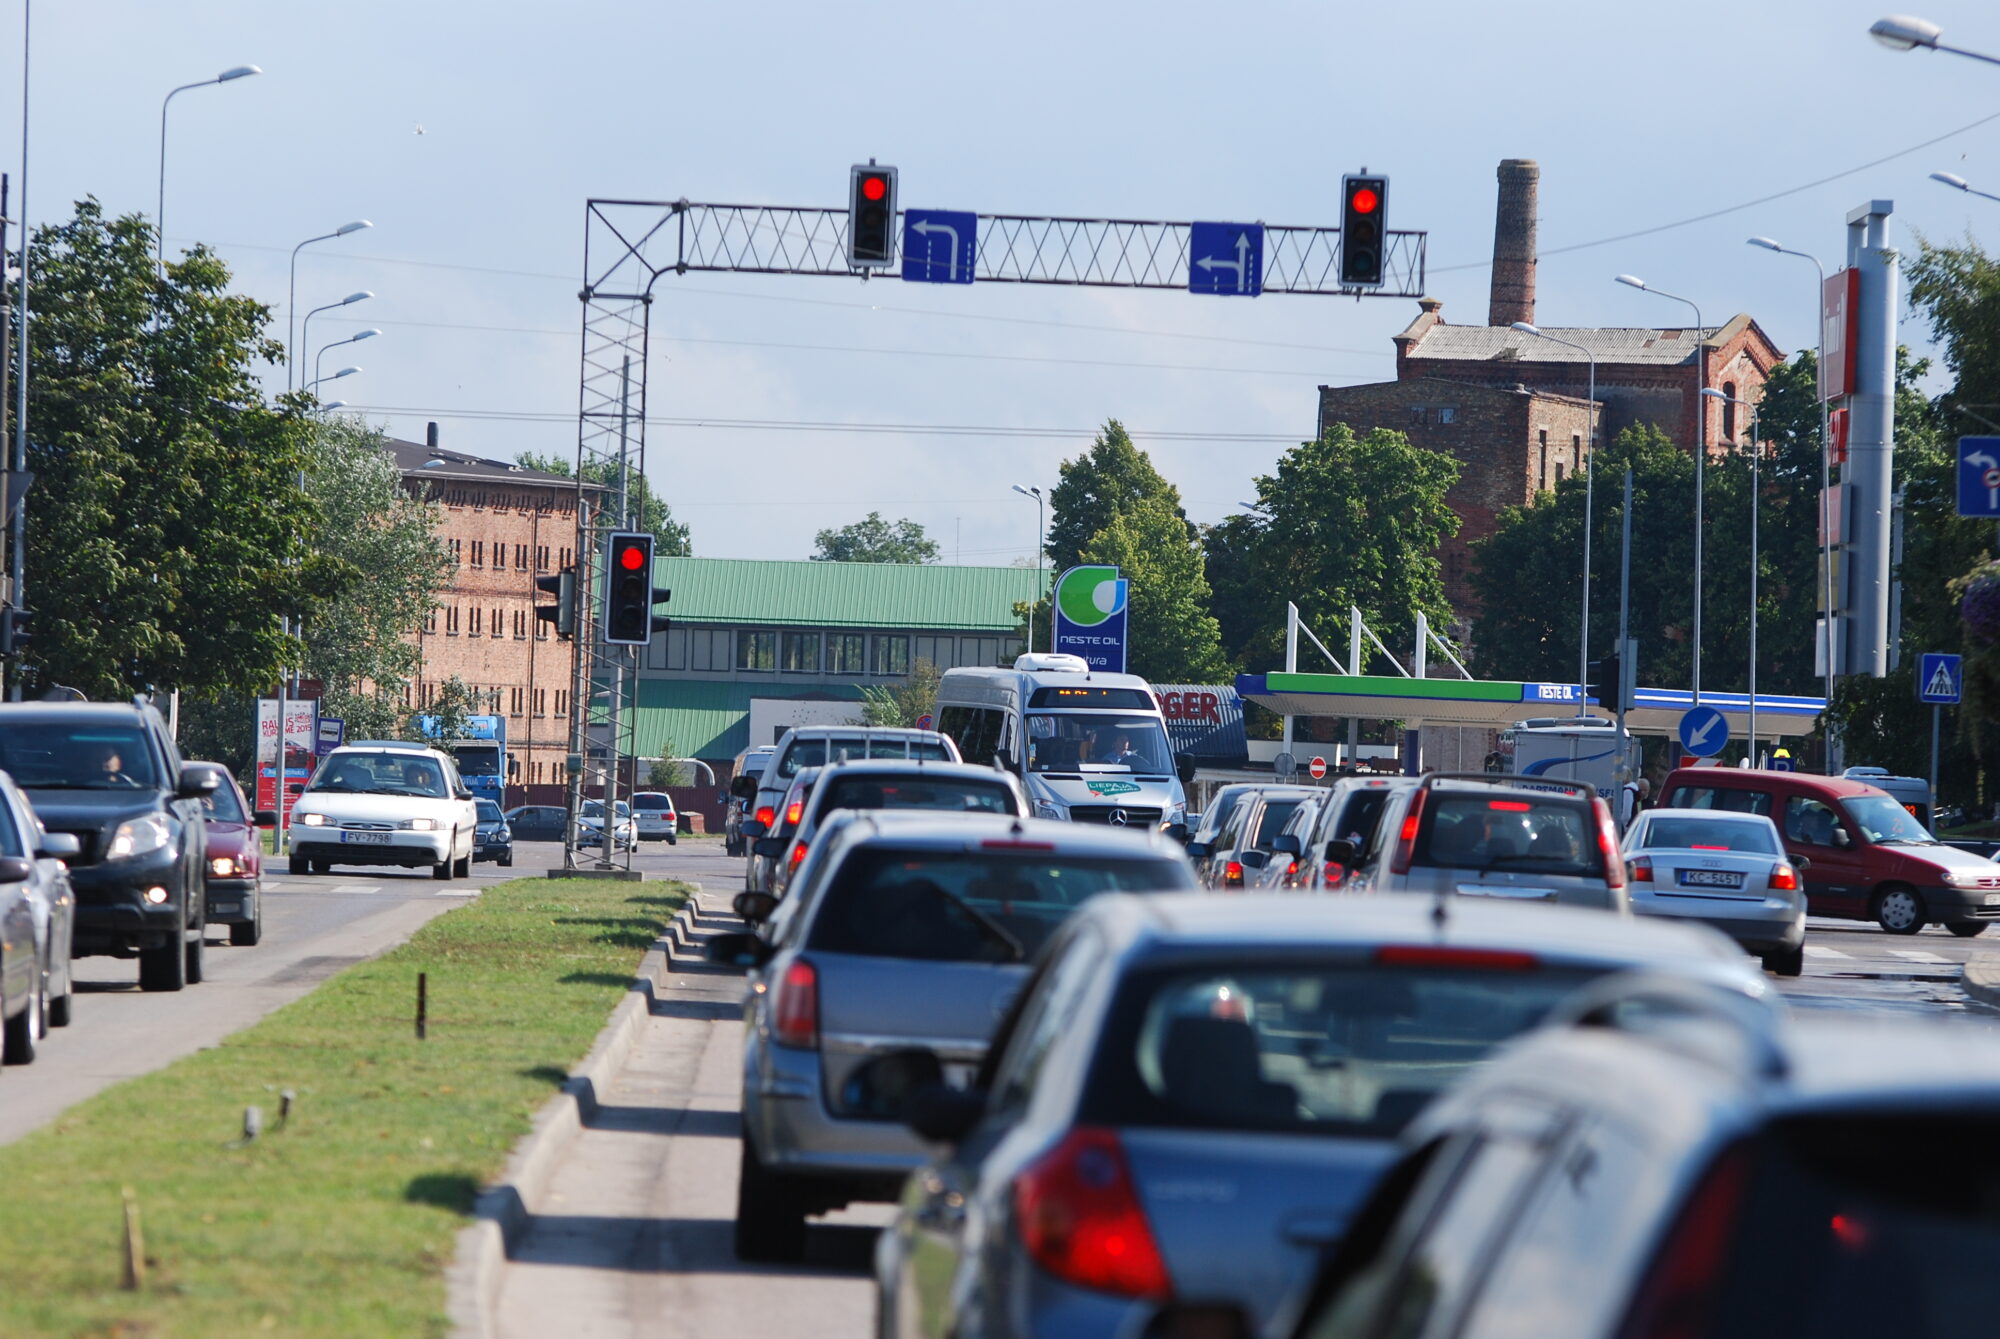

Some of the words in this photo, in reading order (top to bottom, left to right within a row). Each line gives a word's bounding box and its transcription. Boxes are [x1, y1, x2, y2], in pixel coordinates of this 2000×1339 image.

[1060, 635, 1101, 645] NESTE
[1102, 636, 1120, 646] OIL
[1083, 655, 1107, 666] tura
[1538, 685, 1562, 699] NESTE
[1688, 871, 1739, 884] KC-5451
